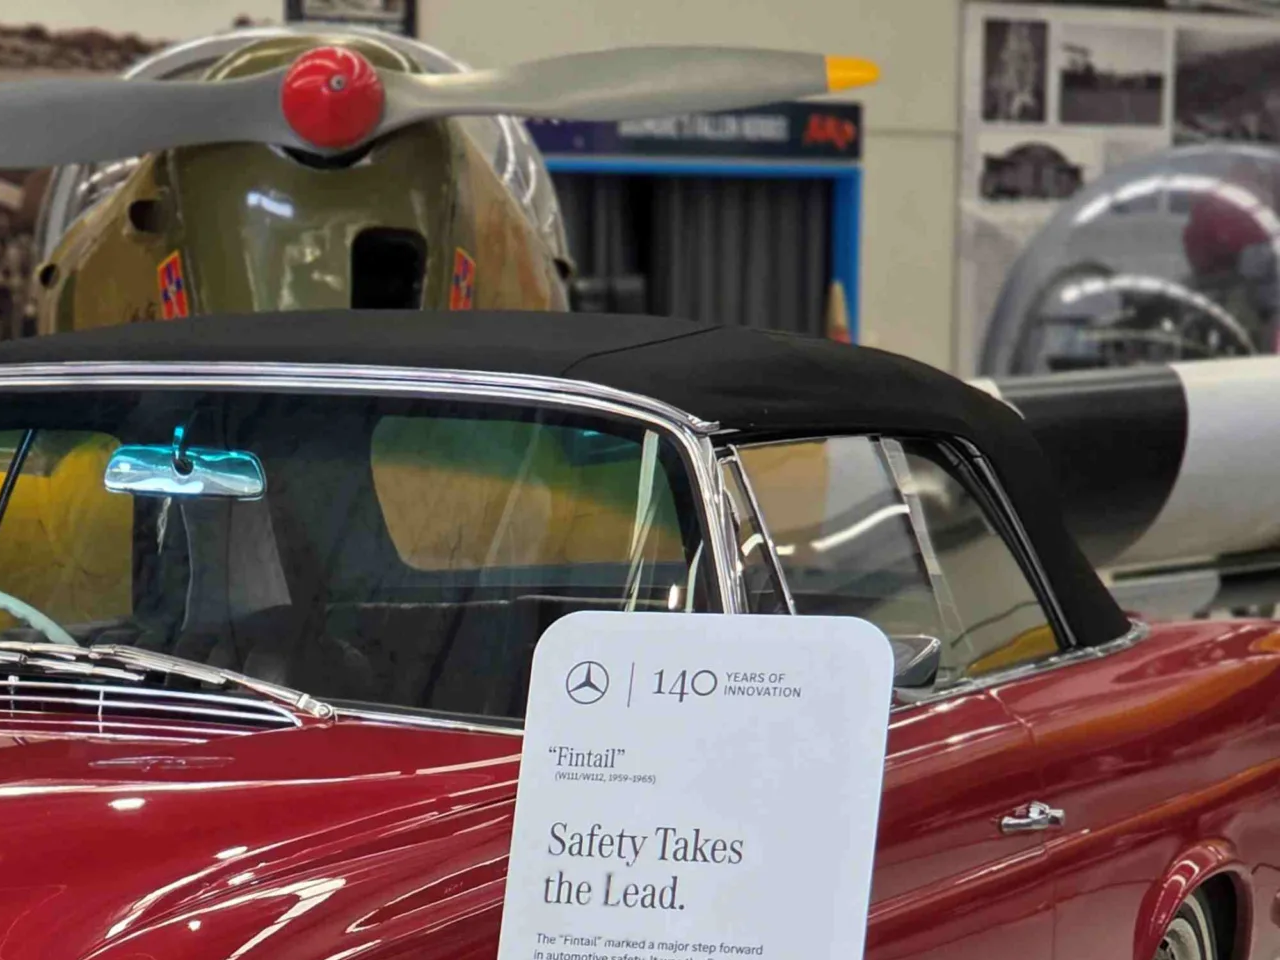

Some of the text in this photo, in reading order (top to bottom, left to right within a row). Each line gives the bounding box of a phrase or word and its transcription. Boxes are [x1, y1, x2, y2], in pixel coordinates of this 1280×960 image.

[652, 669, 718, 703] 140
[725, 672, 786, 684] YEARS OF
[724, 685, 802, 698] INNOVATION
[547, 822, 745, 867] Safety Takes
[543, 870, 686, 910] the Lead.
[533, 949, 544, 960] in
[537, 932, 557, 945] The
[604, 938, 646, 950] marked
[648, 941, 655, 950] a
[657, 940, 690, 953] major
[691, 943, 717, 955] step
[719, 942, 764, 956] forward
